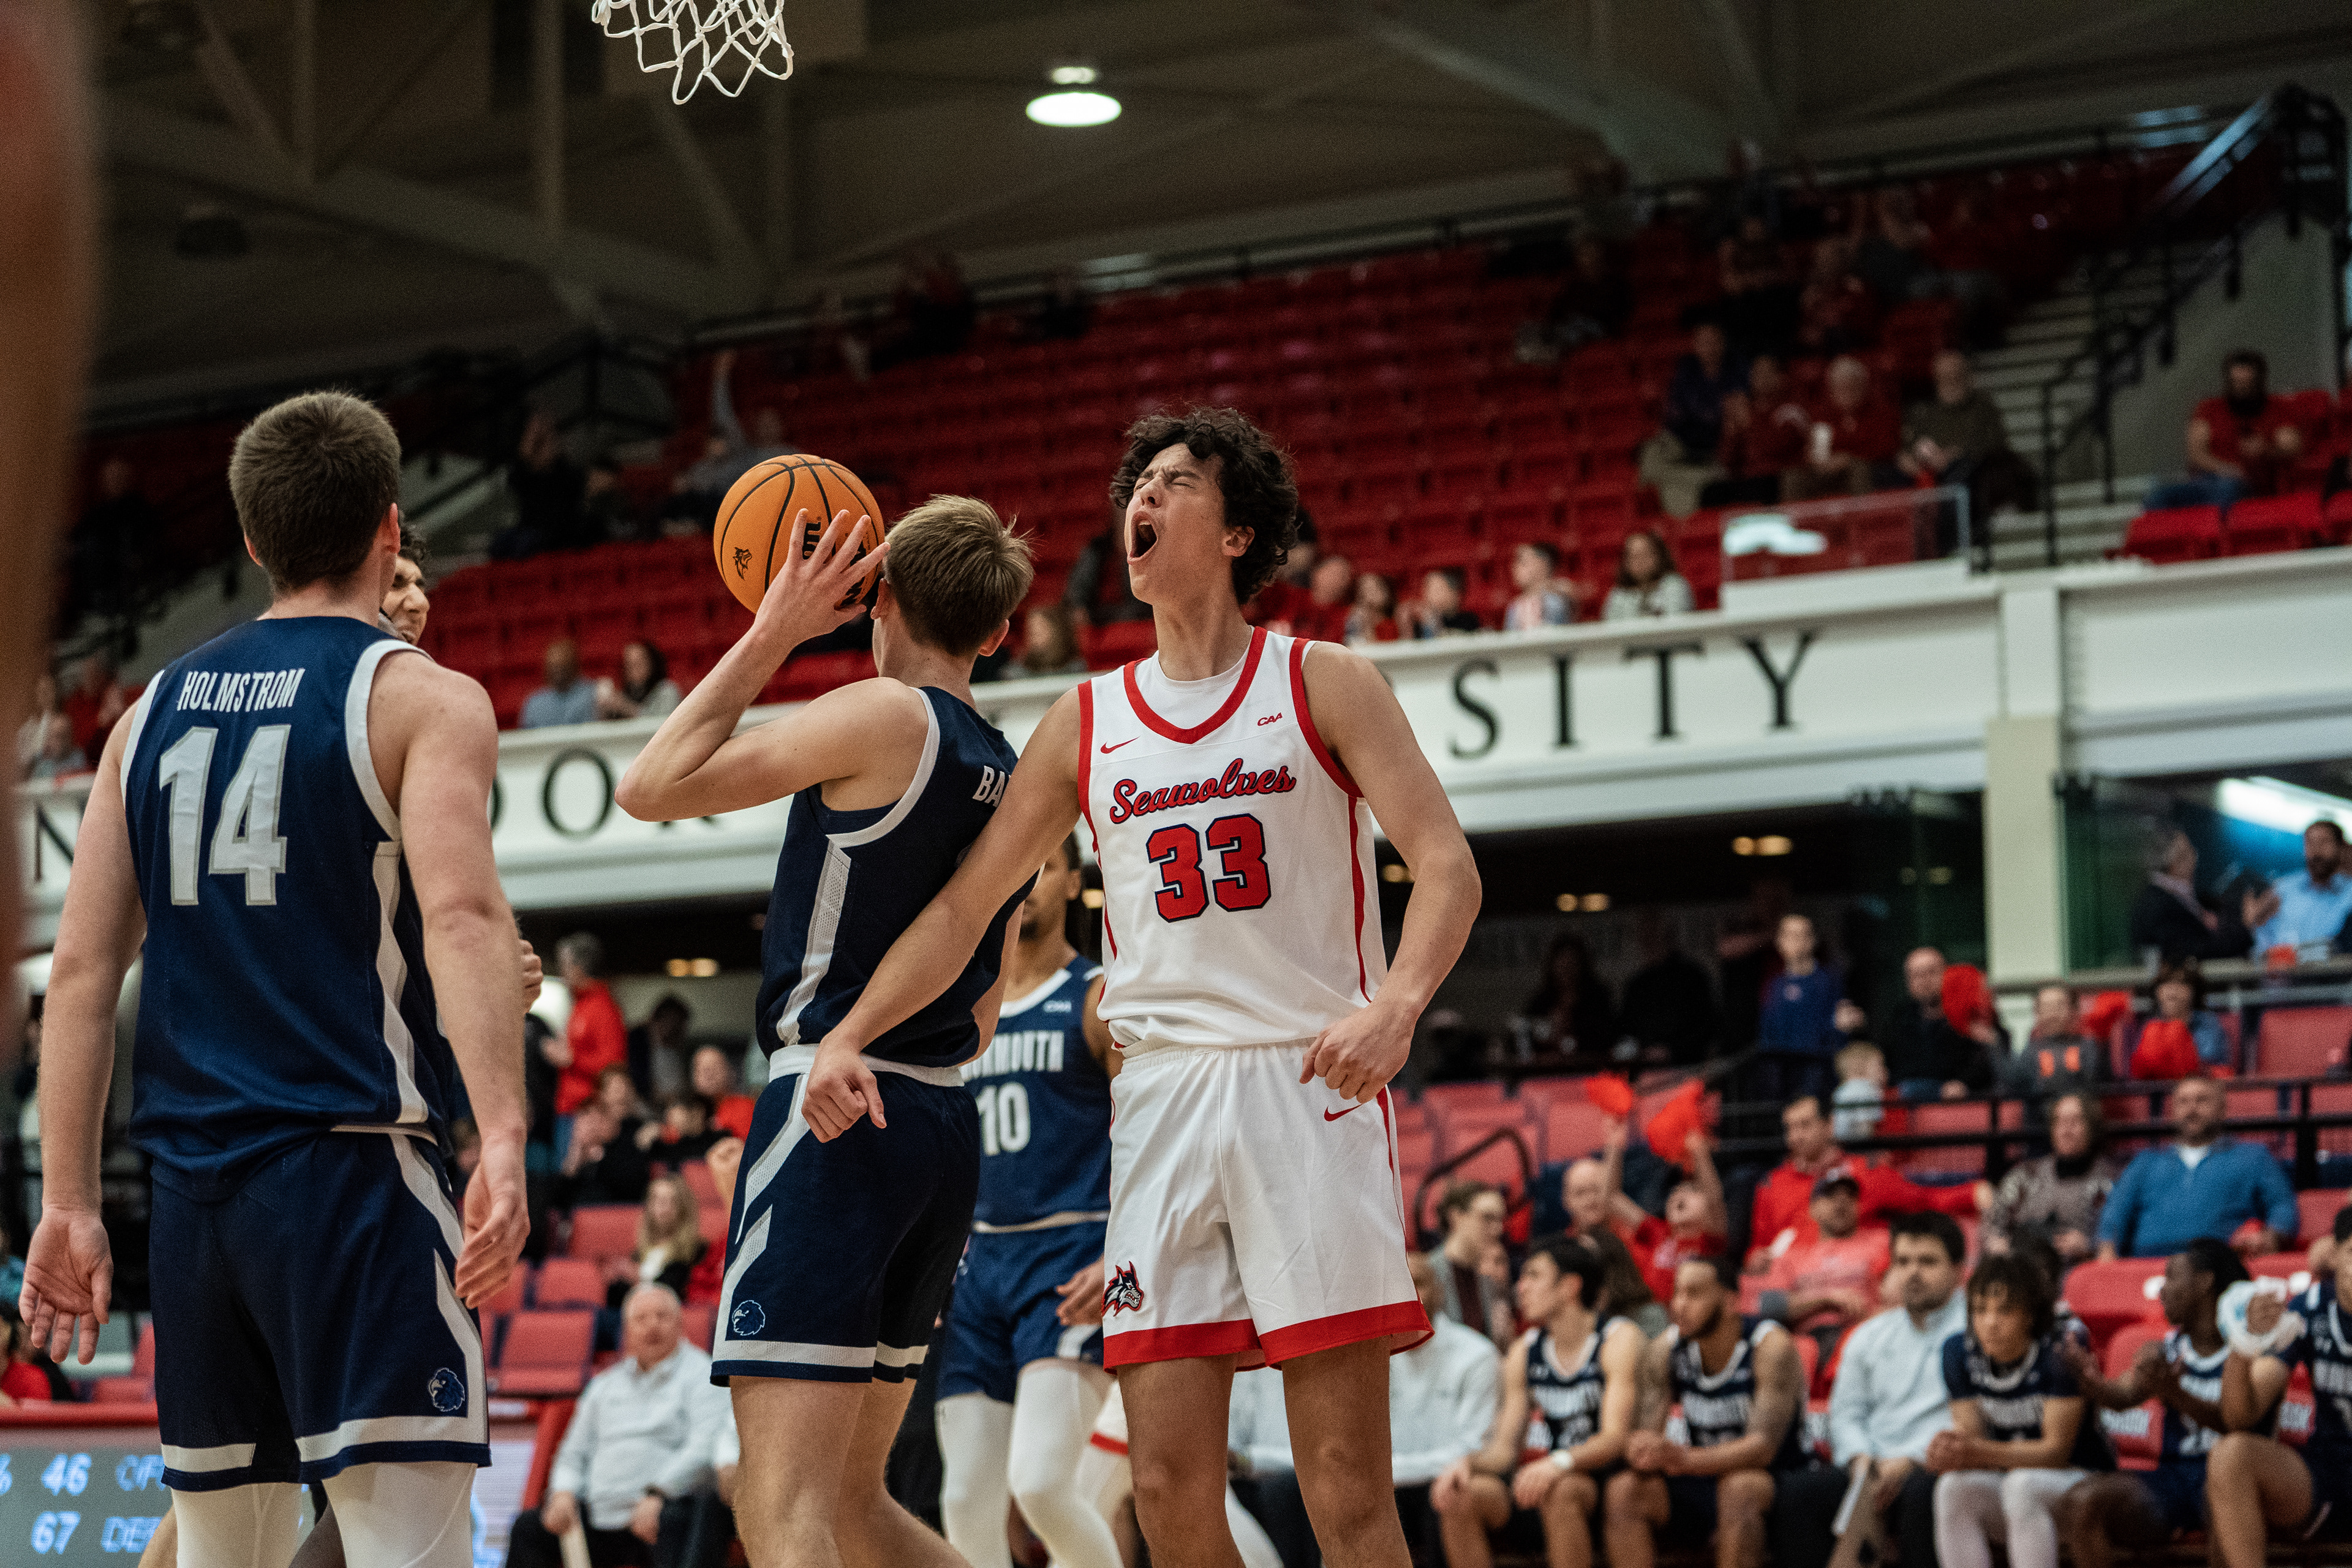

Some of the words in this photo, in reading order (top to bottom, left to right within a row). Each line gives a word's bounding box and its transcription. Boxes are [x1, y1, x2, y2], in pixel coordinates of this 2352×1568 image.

[176, 668, 306, 712] HOLMSTROM
[1257, 712, 1283, 726] CAA
[972, 765, 1011, 808] BA
[1109, 758, 1297, 824] Seawolves
[159, 724, 292, 905] 14
[1145, 813, 1272, 923] 33
[975, 1081, 1031, 1156] 10
[41, 1453, 92, 1496] 46
[31, 1510, 81, 1554] 67
